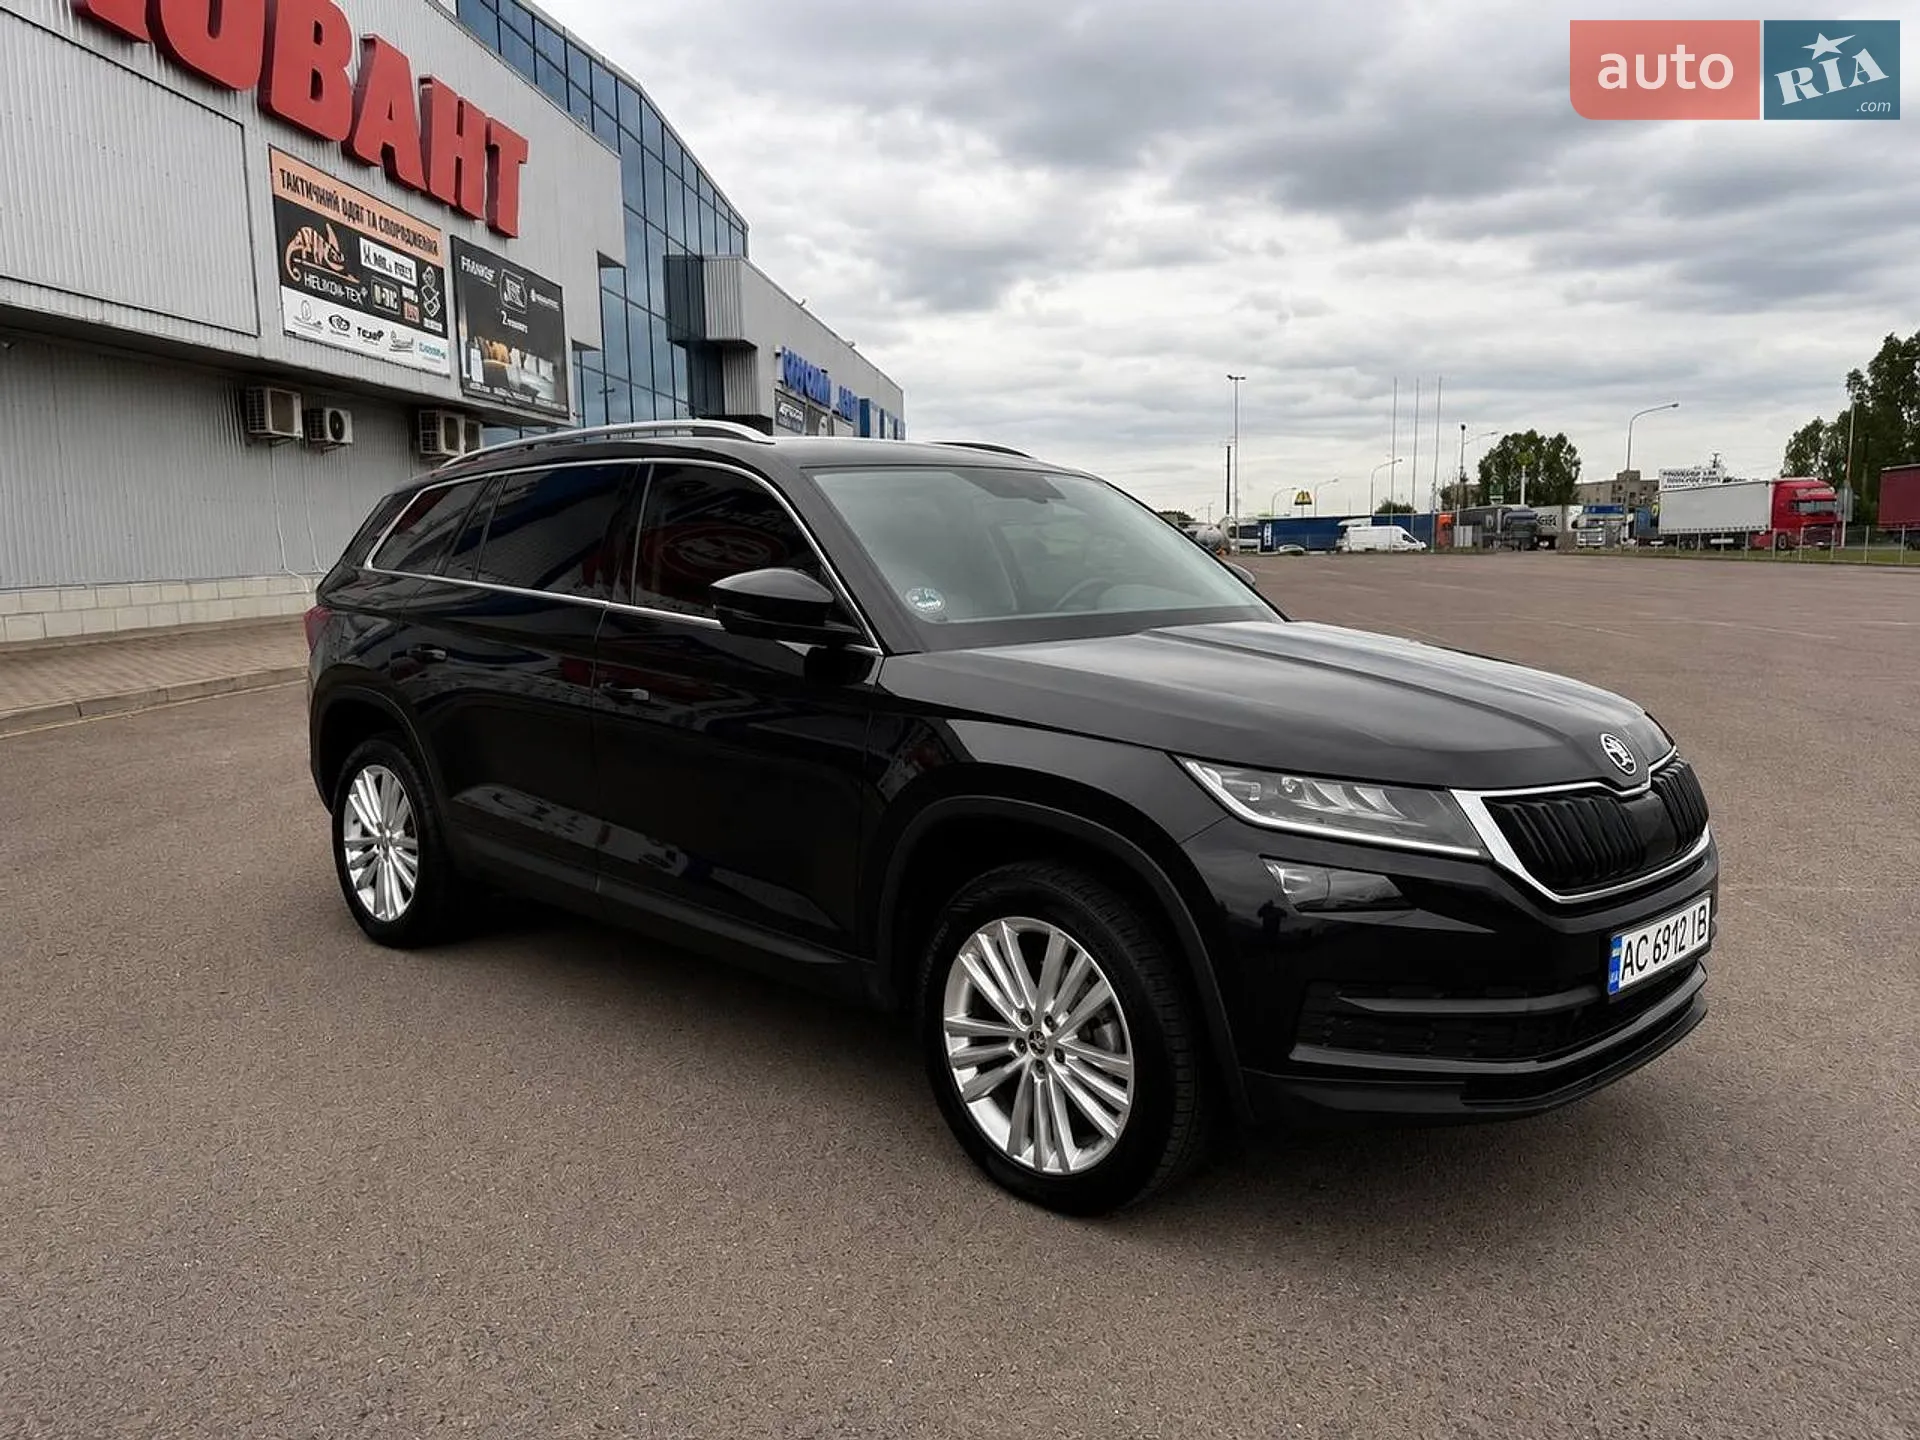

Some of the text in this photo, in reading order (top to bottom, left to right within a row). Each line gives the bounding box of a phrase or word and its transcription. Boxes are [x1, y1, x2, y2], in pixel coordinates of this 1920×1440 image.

[365, 208, 379, 231] ТА
[1621, 904, 1707, 981] AC 6912 IB
